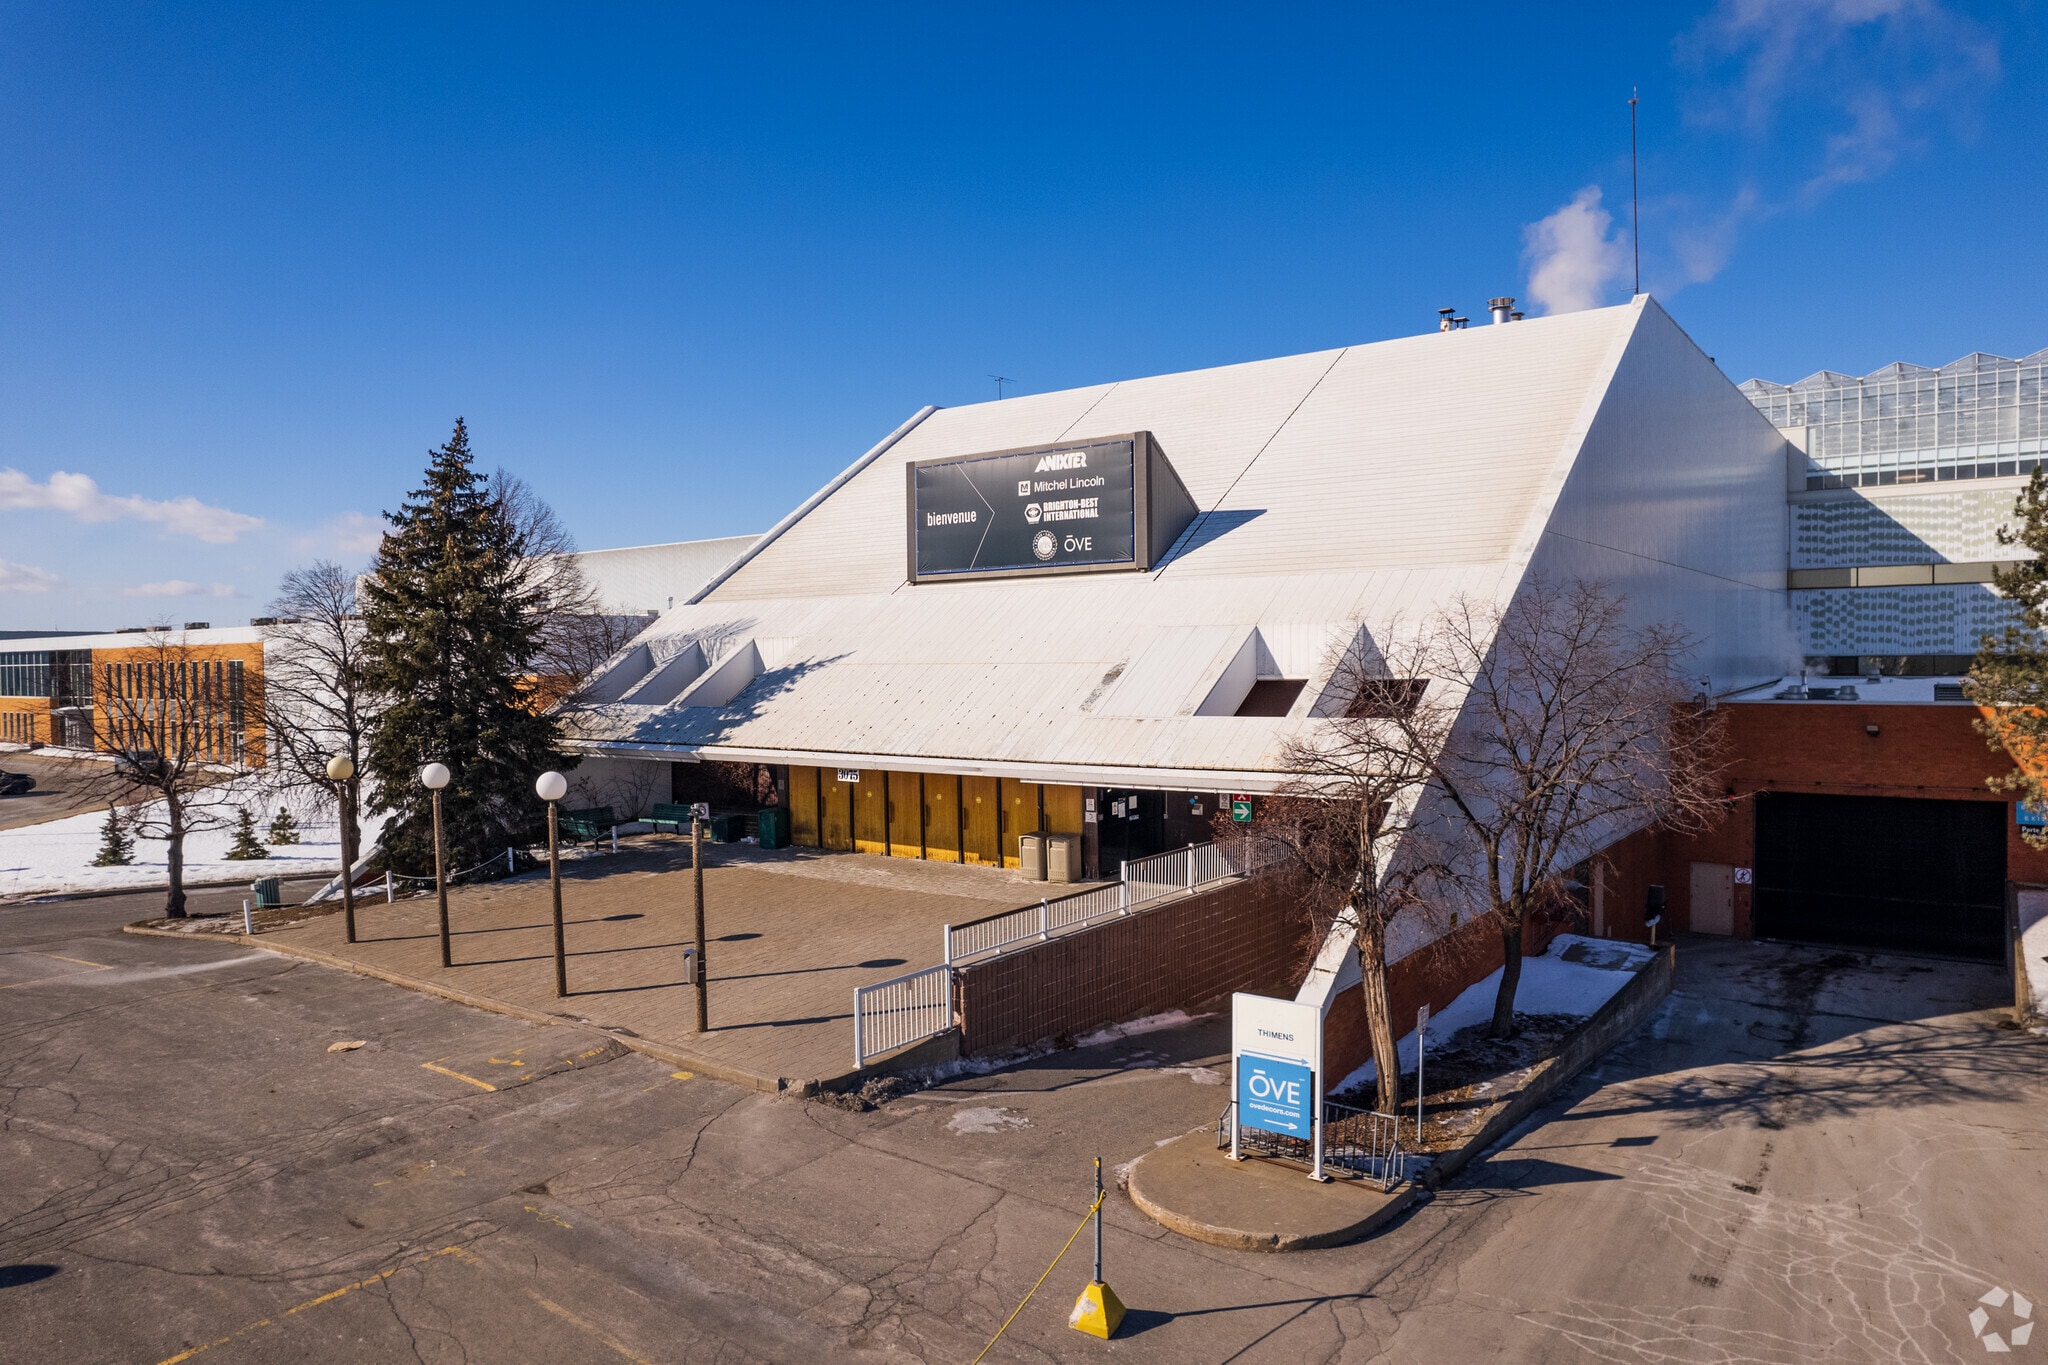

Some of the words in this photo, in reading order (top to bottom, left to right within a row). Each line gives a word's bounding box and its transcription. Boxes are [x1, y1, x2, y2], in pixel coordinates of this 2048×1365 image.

[1034, 452, 1087, 473] ANIXTER
[1034, 478, 1067, 493] Mitchel
[1069, 475, 1105, 489] Lincoln
[1043, 498, 1099, 512] BRIGHTON-BEST
[927, 511, 977, 527] bienvenue
[1043, 508, 1099, 522] INTERNATIONAL
[1257, 1029, 1295, 1042] THIMENS
[1249, 1103, 1300, 1118] ovedecors.com
